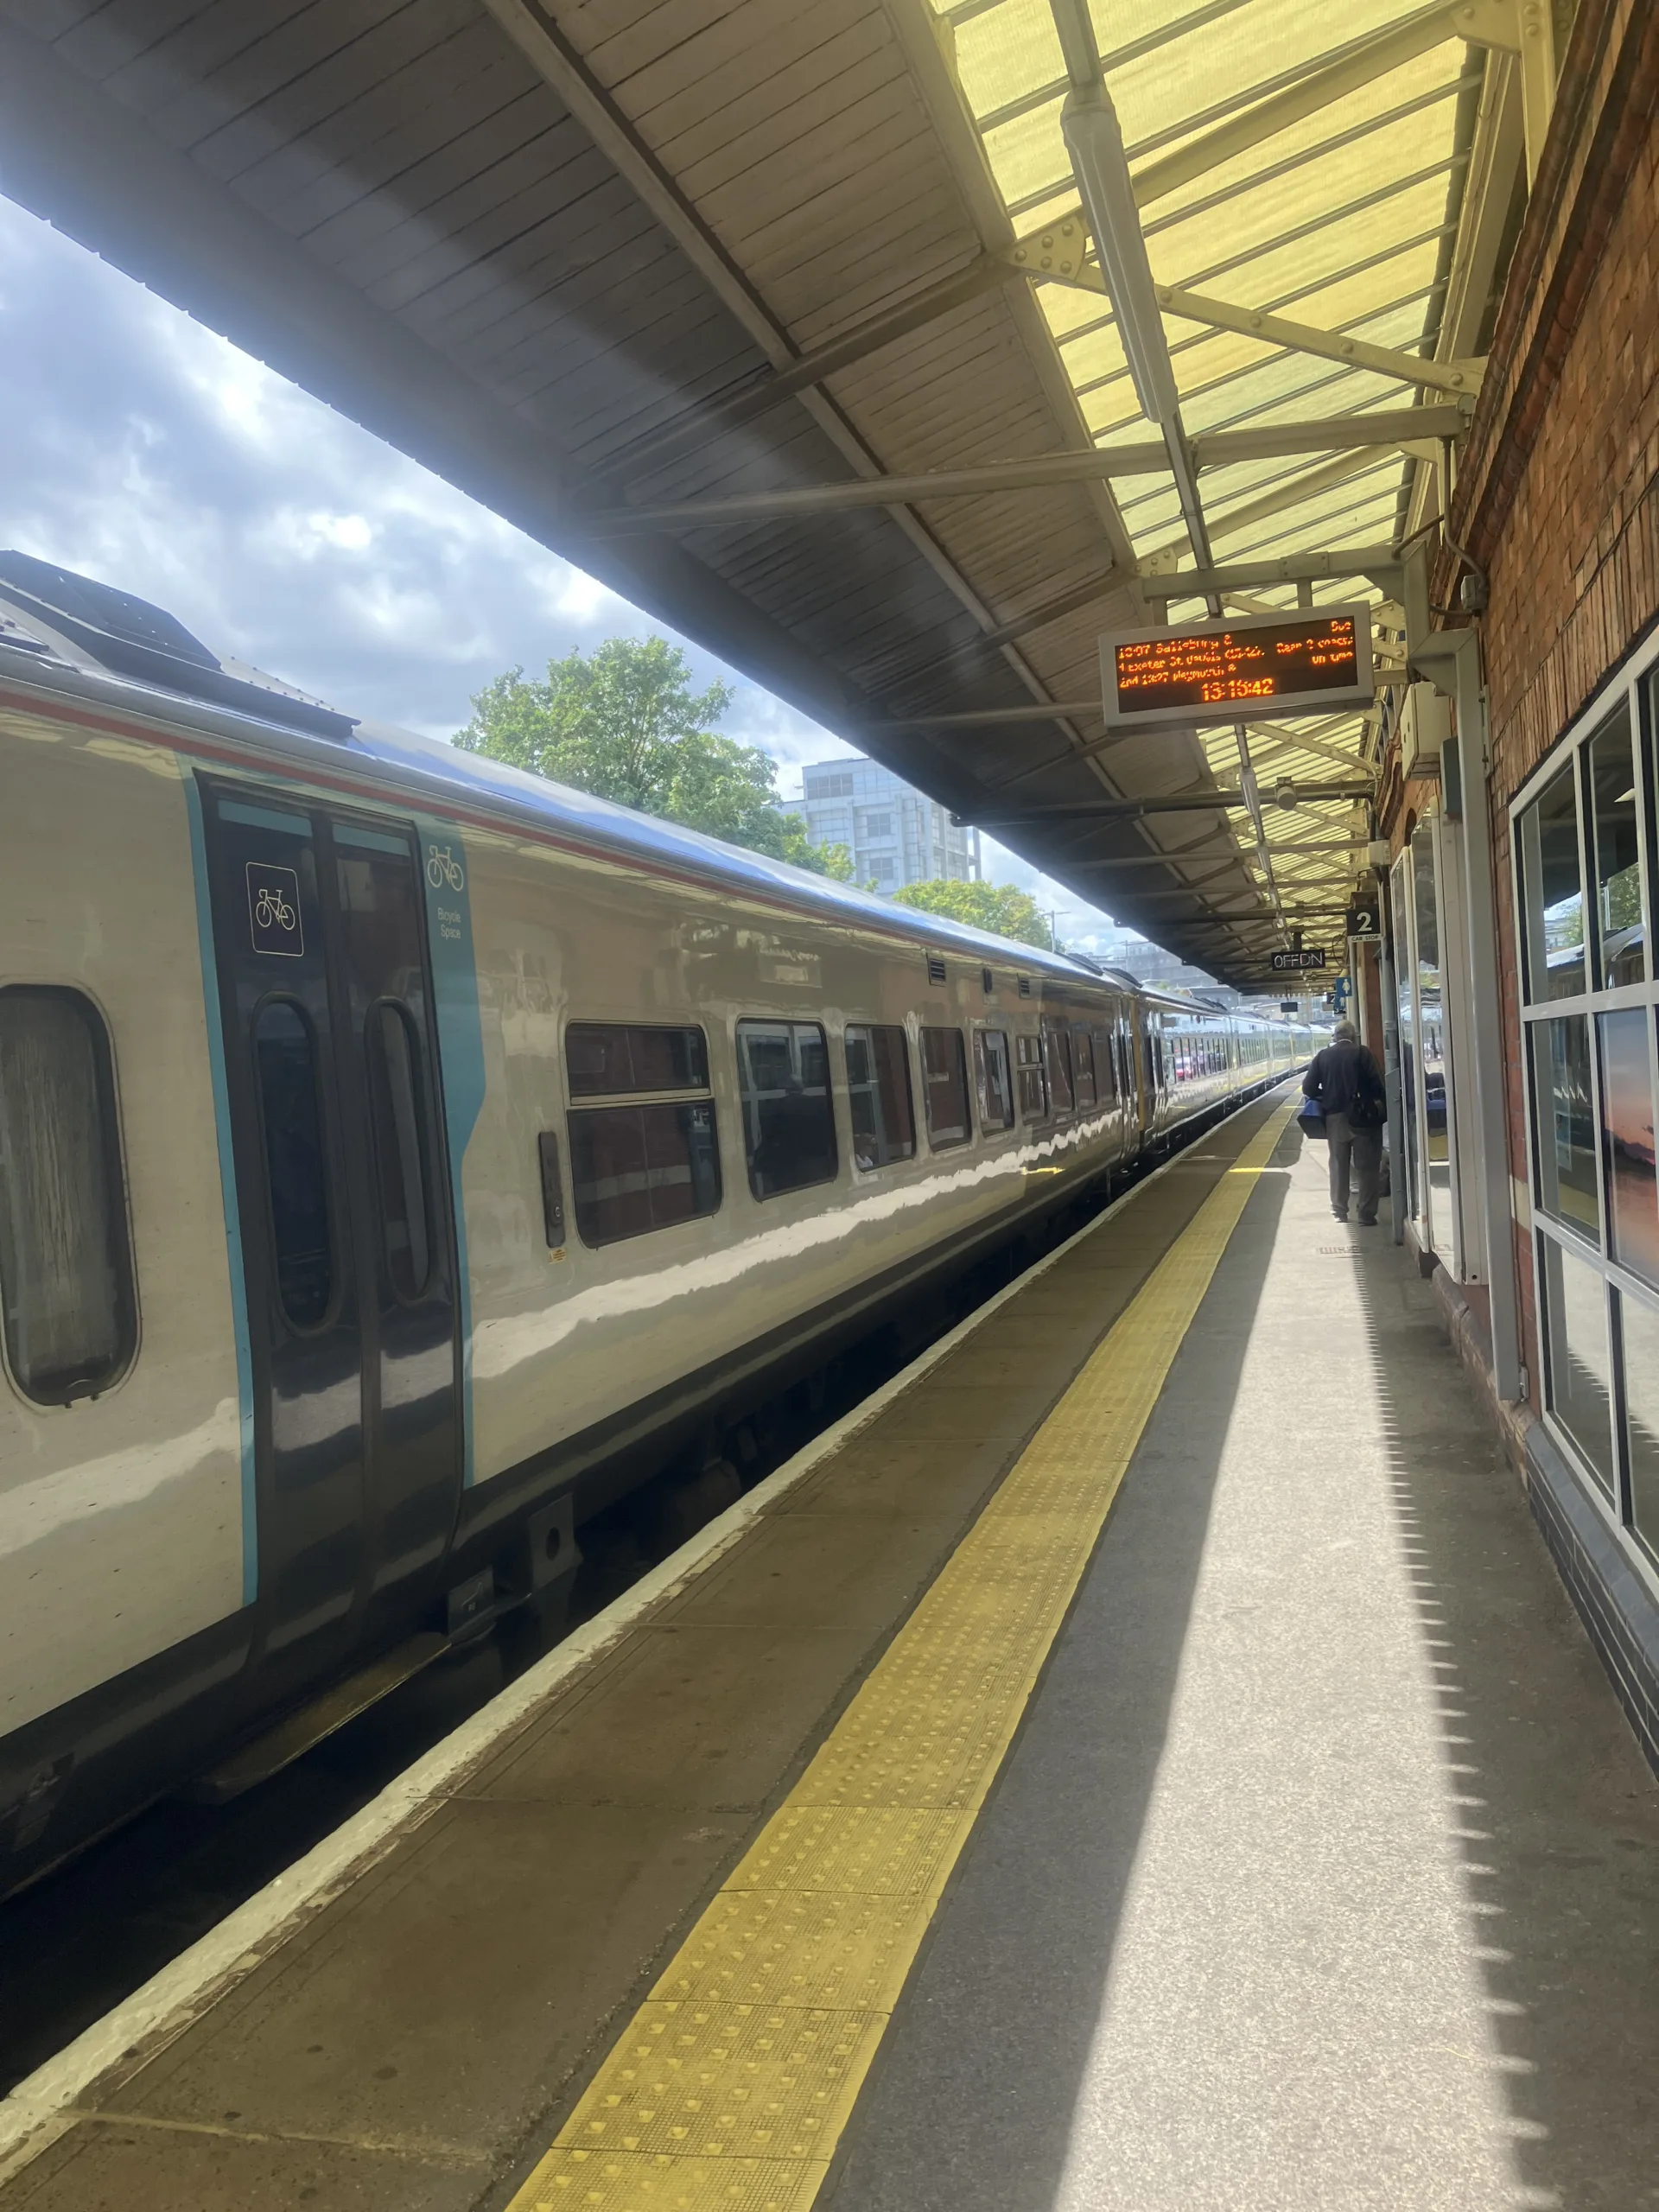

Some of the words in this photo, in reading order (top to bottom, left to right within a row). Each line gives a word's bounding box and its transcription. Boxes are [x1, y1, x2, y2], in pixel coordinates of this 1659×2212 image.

[437, 907, 461, 924] Bicycle
[1357, 912, 1372, 932] 2
[441, 924, 461, 941] Space
